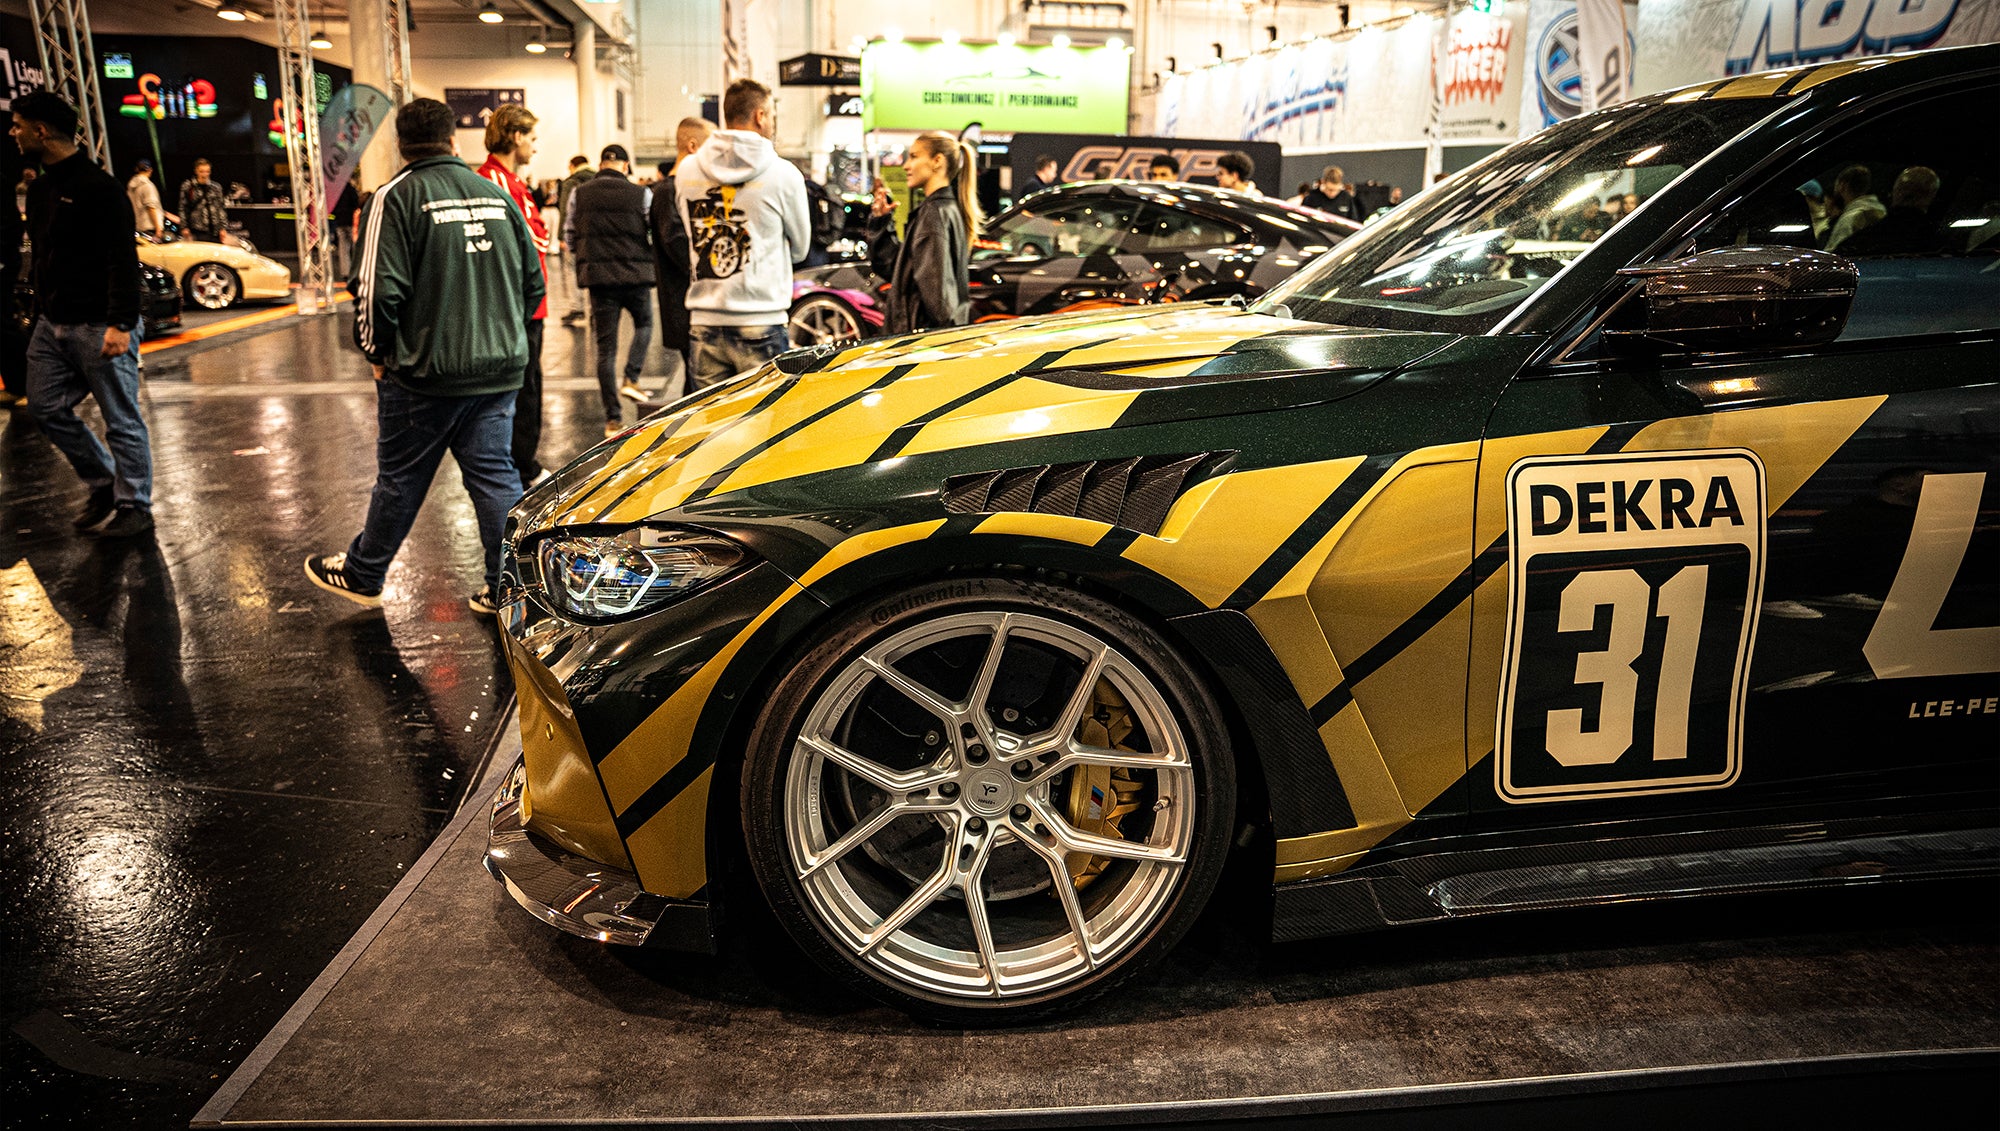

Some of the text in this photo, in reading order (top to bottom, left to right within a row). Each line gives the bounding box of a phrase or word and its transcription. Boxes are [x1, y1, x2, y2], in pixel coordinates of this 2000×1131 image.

[1529, 475, 1745, 537] DEKRA
[871, 580, 973, 626] Continental
[1545, 564, 1709, 768] 31
[1908, 697, 1999, 719] LCE-PE
